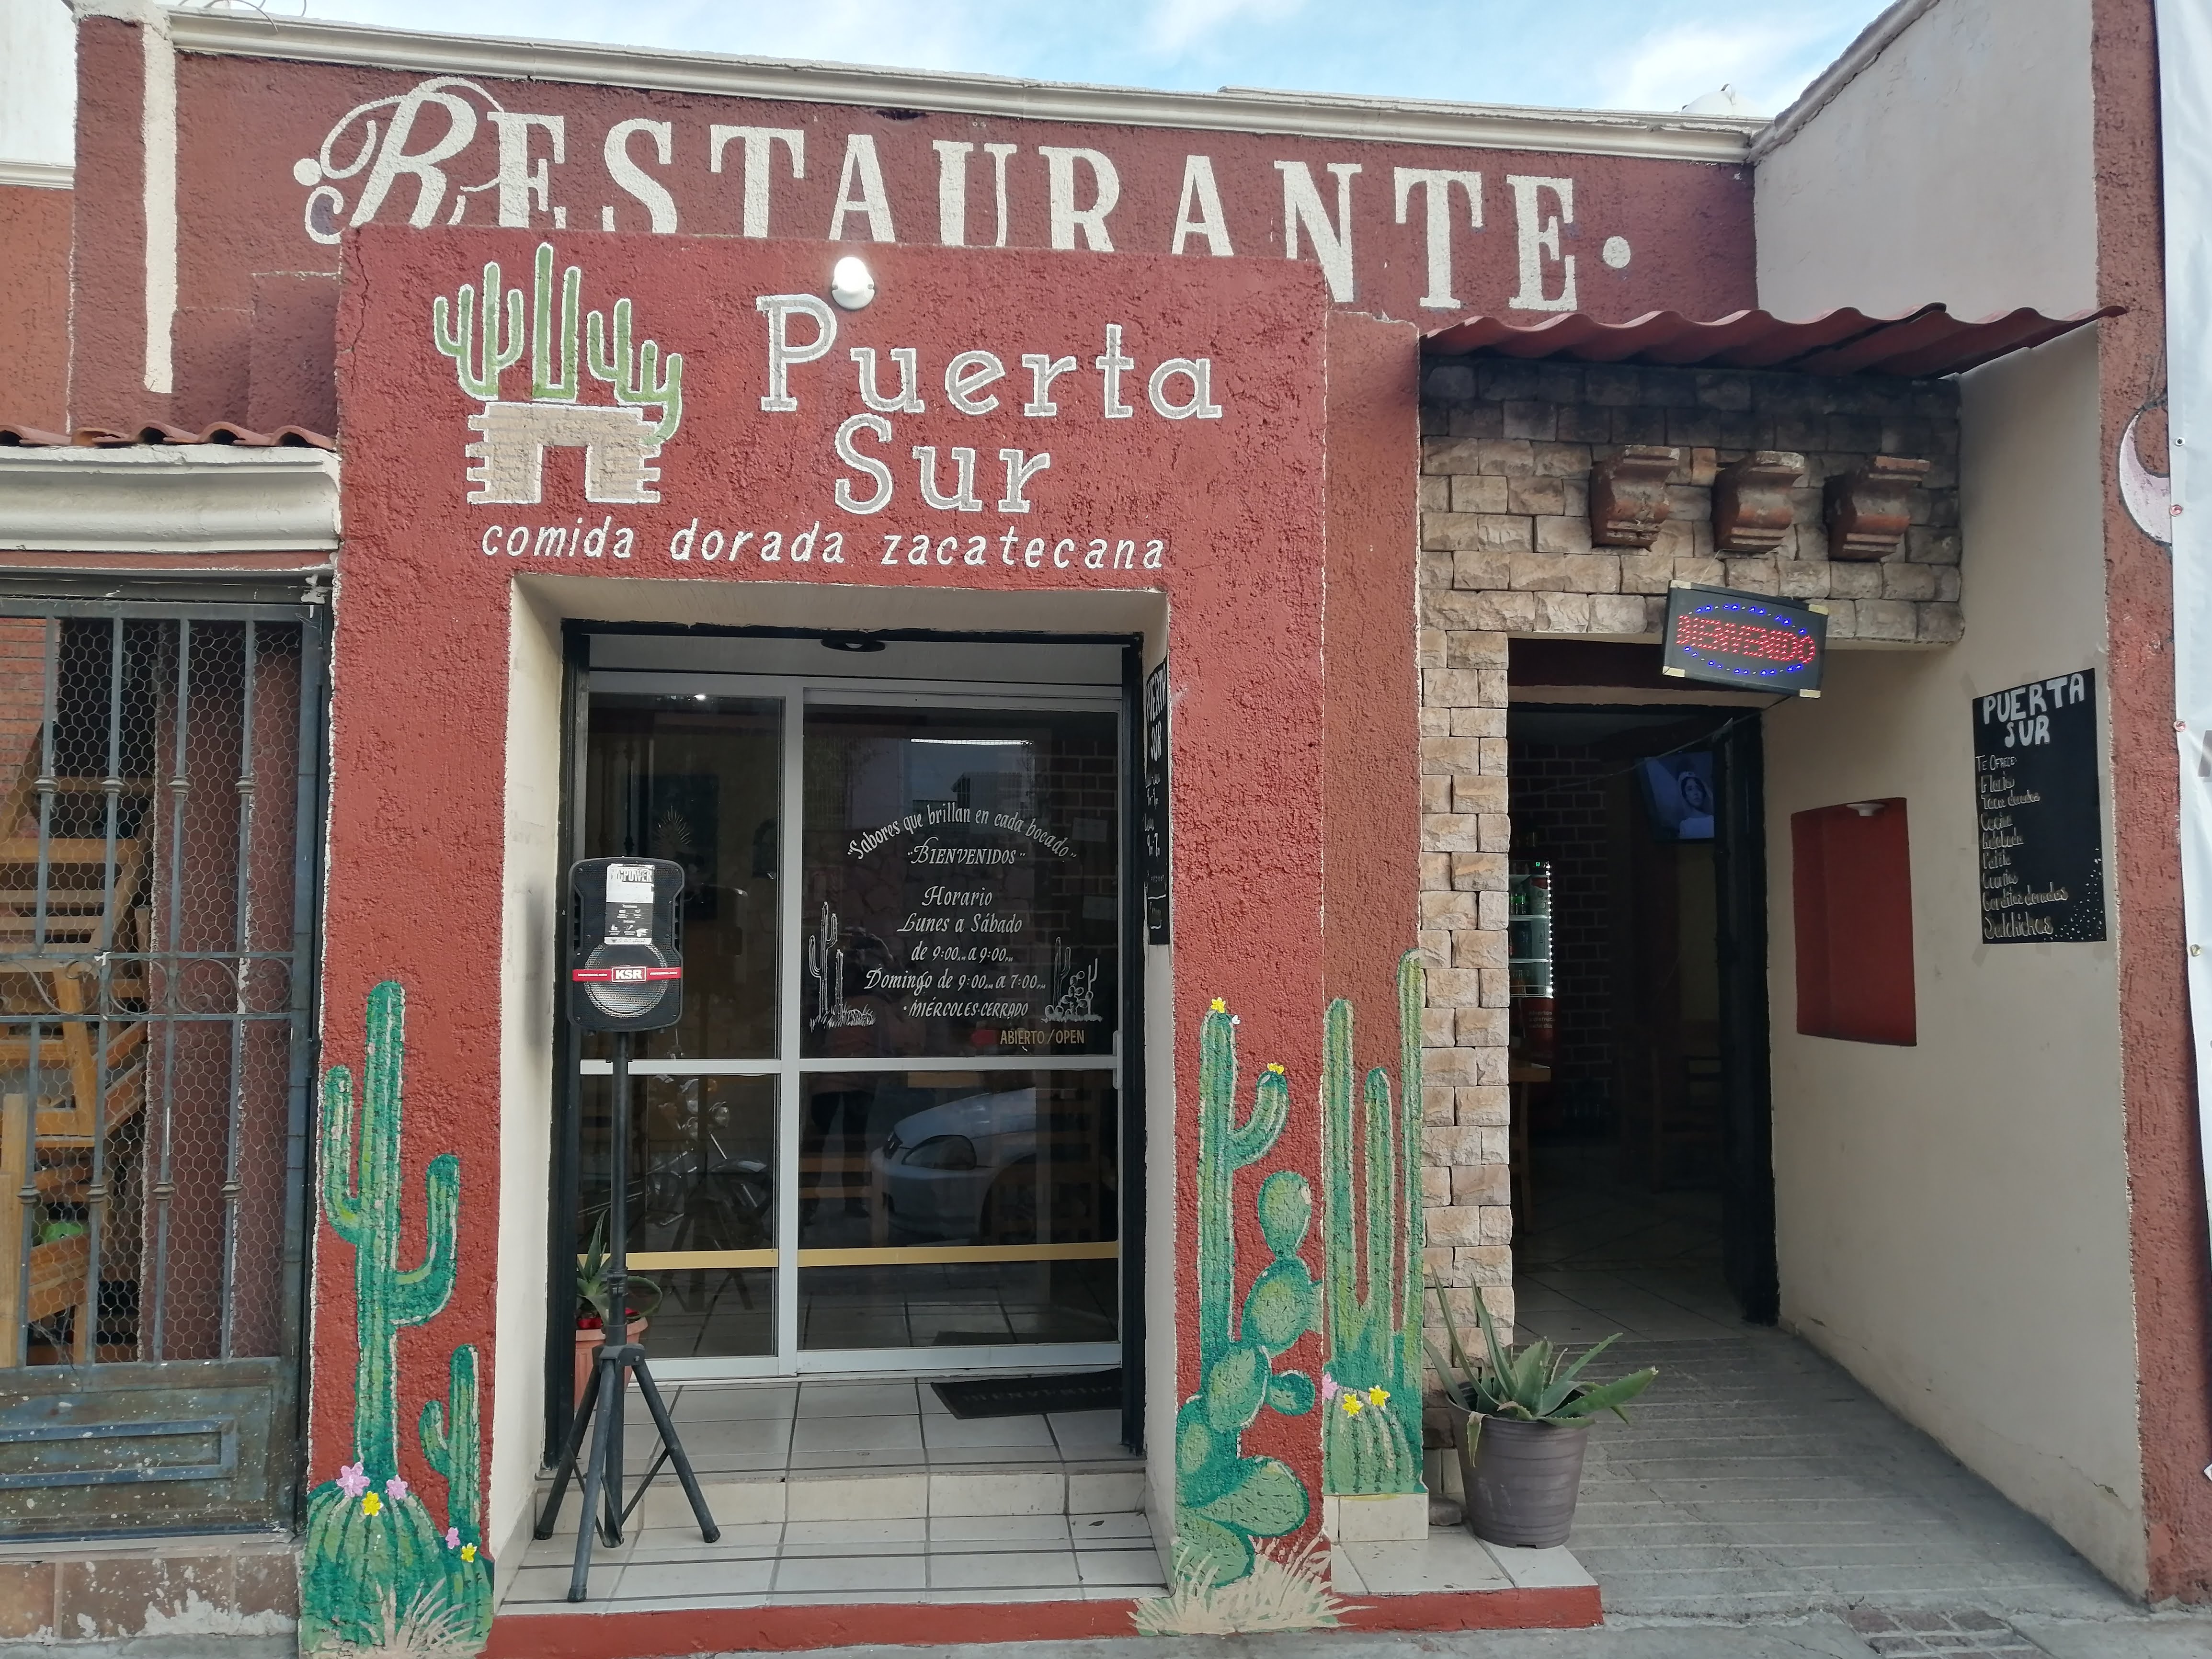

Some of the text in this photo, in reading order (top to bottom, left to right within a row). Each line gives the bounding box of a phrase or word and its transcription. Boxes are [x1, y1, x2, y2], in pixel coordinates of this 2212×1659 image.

[755, 294, 1223, 419] Puerta
[834, 413, 1050, 514] Sur
[482, 516, 1164, 569] comida dorada zacatecana
[1676, 614, 1815, 664] BIENVENIDO
[1983, 673, 2085, 725] PUERTA
[2005, 715, 2050, 748] SUR
[903, 814, 923, 834] que
[927, 802, 970, 825] brillan
[976, 810, 989, 824] en
[994, 812, 1024, 832] cada
[922, 886, 993, 907] Horario
[896, 912, 1023, 933] Lunes a Sábado
[911, 941, 928, 961] de
[968, 947, 977, 961] a
[616, 969, 642, 979] KSR
[864, 967, 933, 996] Domingo
[937, 968, 952, 989] de
[996, 975, 1006, 989] a
[1000, 1031, 1044, 1045] ABIERTO
